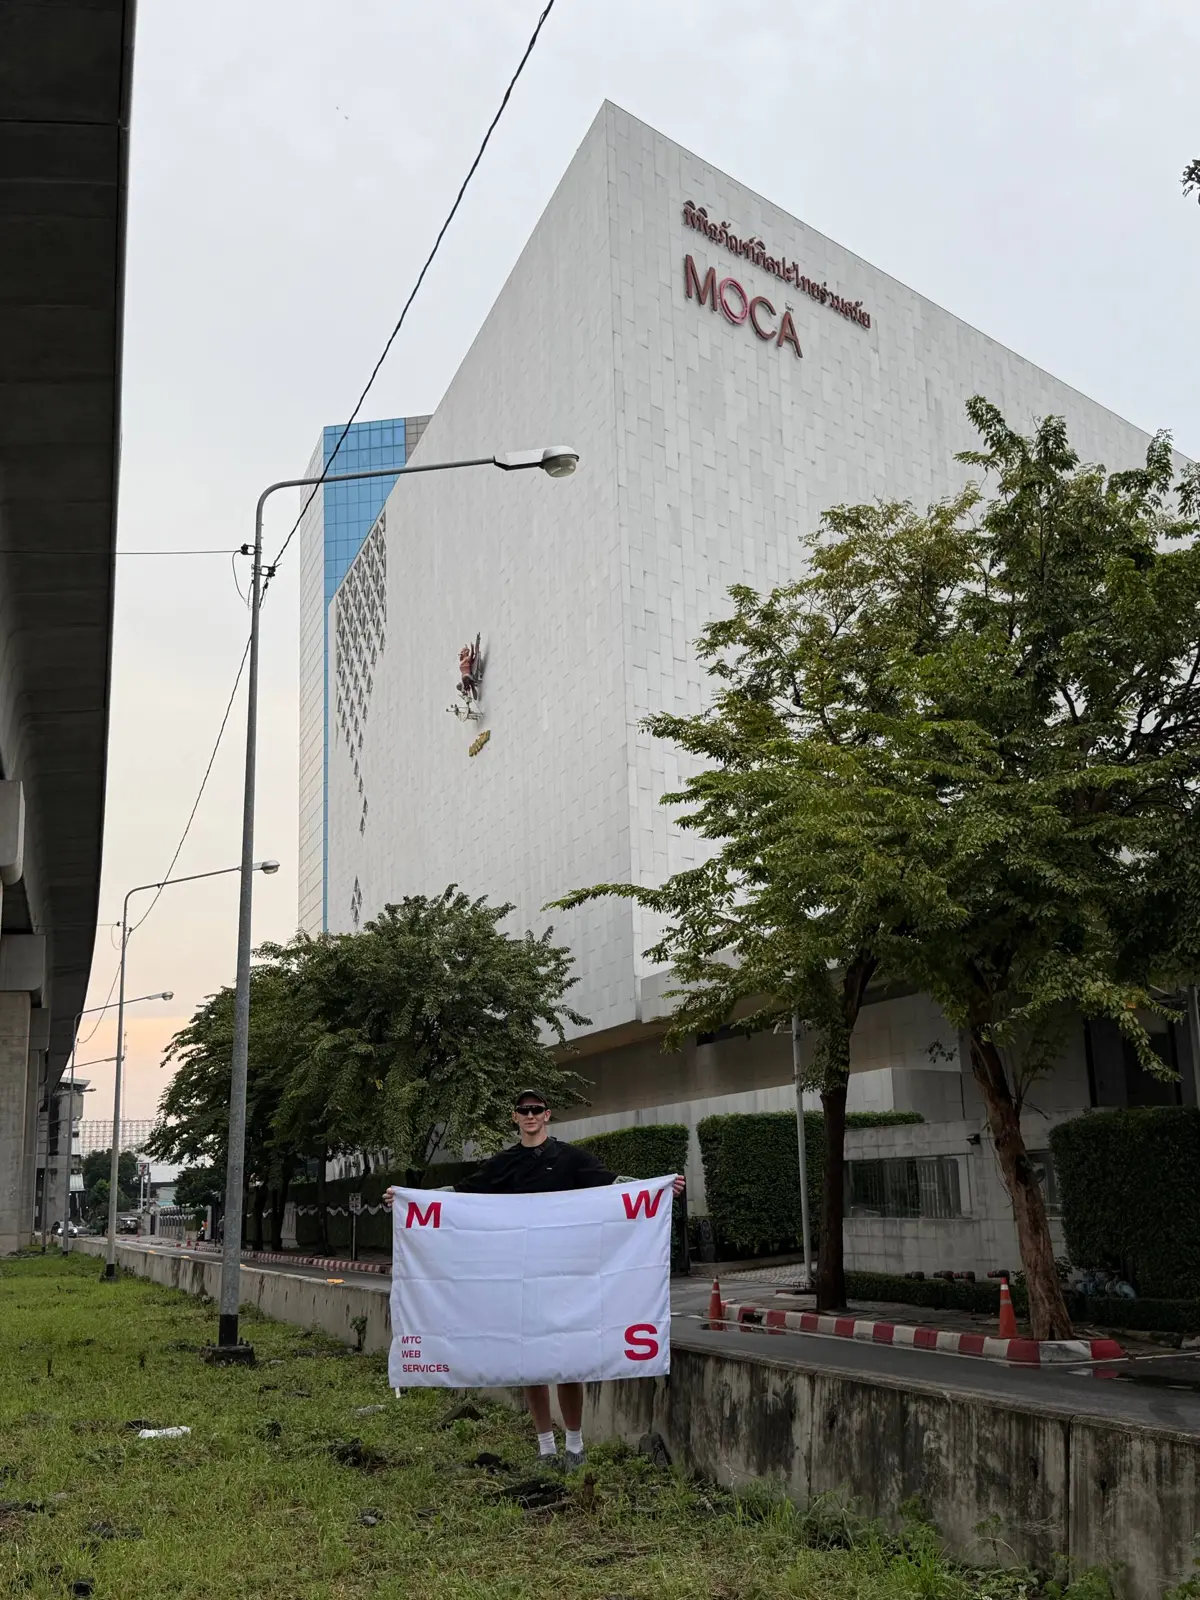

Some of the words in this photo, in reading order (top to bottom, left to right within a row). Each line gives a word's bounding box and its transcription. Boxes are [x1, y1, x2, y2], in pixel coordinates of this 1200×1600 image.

[683, 199, 871, 329] พิพิธภัณฑ์ศิลปะไทยร่วมสมัย
[684, 254, 803, 358] MOCA
[405, 1201, 442, 1229] M
[622, 1188, 664, 1220] W
[401, 1335, 422, 1345] MTC
[401, 1349, 421, 1359] WEB
[624, 1323, 659, 1361] S
[402, 1363, 450, 1373] SERVICES
